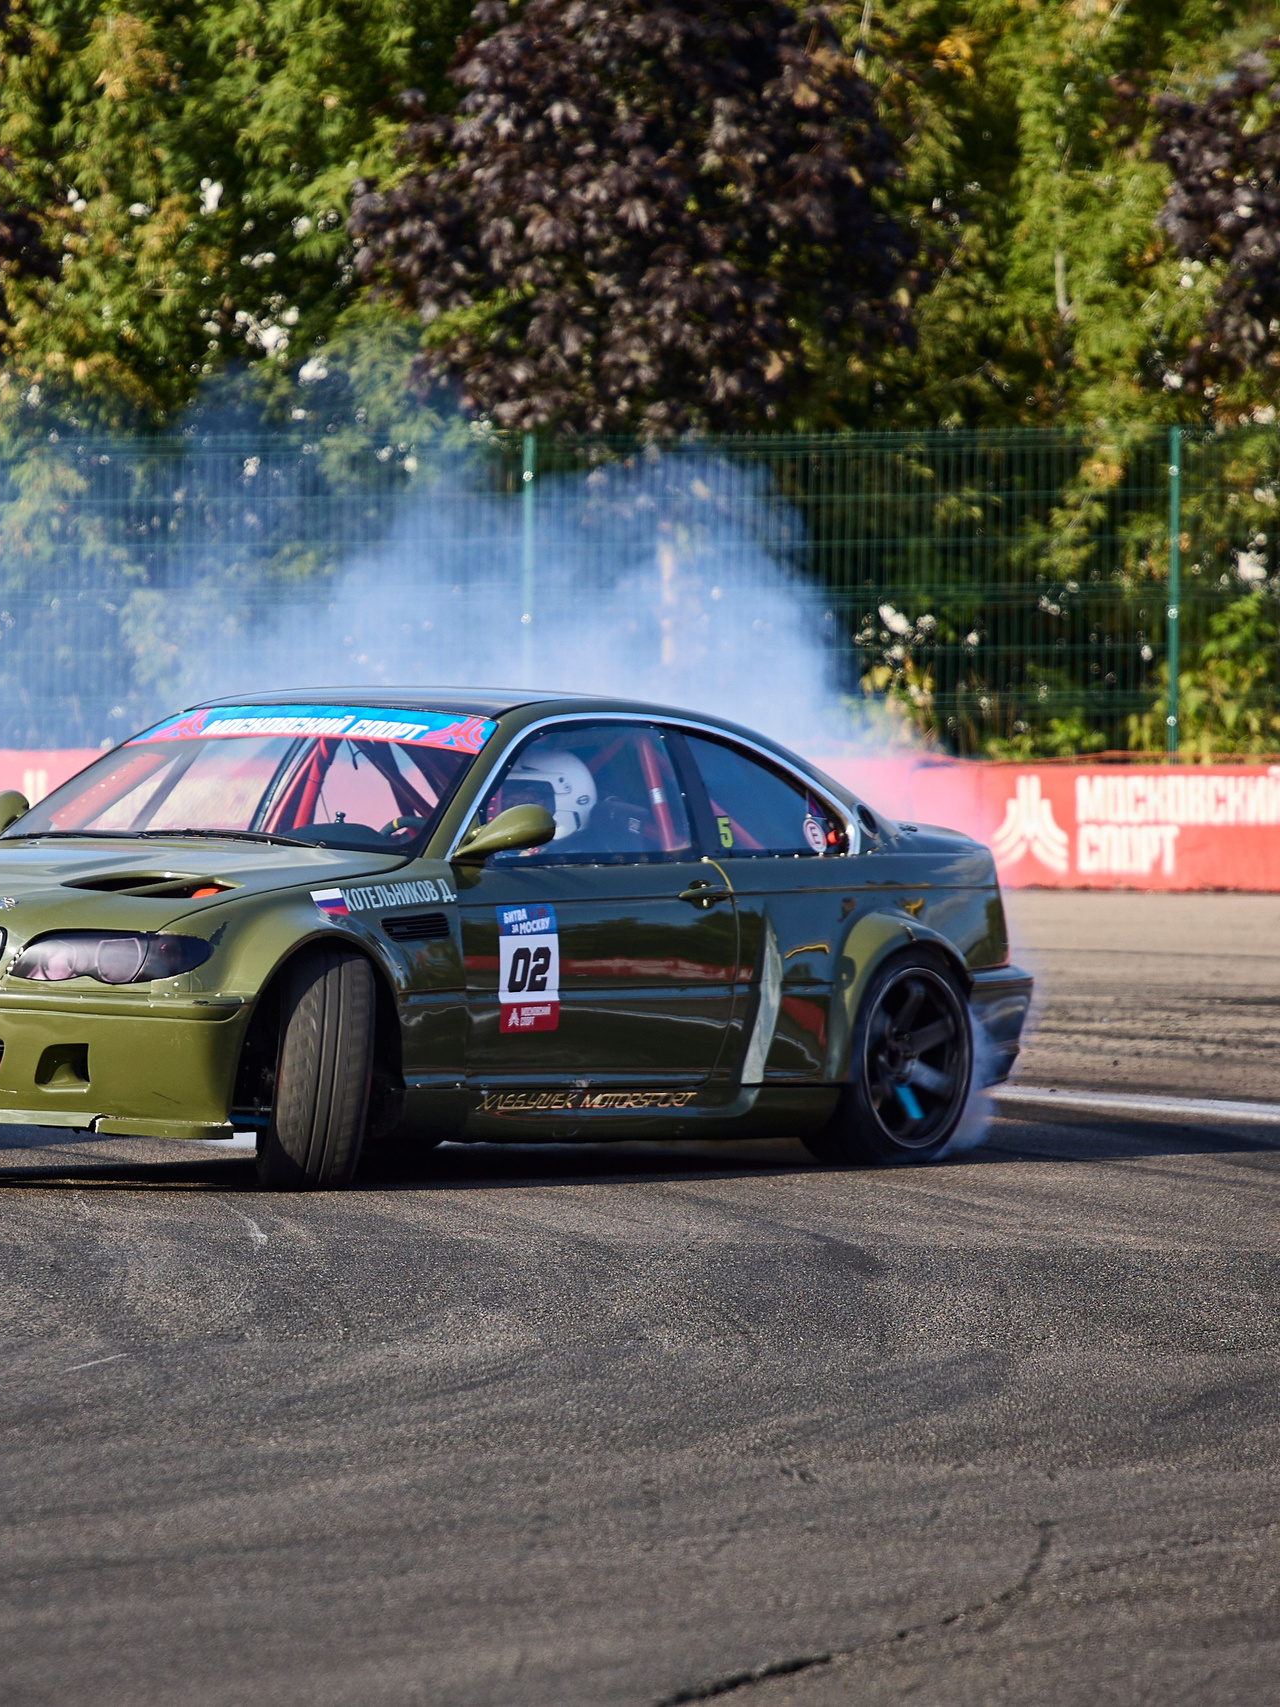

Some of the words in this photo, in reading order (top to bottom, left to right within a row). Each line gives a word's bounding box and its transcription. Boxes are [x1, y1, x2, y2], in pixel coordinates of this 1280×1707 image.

[200, 715, 351, 735] МОСКОВСКИЙ
[347, 719, 429, 740] СПОРТ
[1076, 824, 1180, 875] СПОРТ
[341, 879, 439, 912] КОТЕЛЬНИКОВ
[436, 878, 457, 903] Д.
[503, 908, 528, 924] БИТВА
[511, 924, 519, 934] ЗА
[519, 917, 551, 934] МОСКВУ
[507, 947, 552, 992] 02
[580, 1092, 698, 1108] MOTORSPORT
